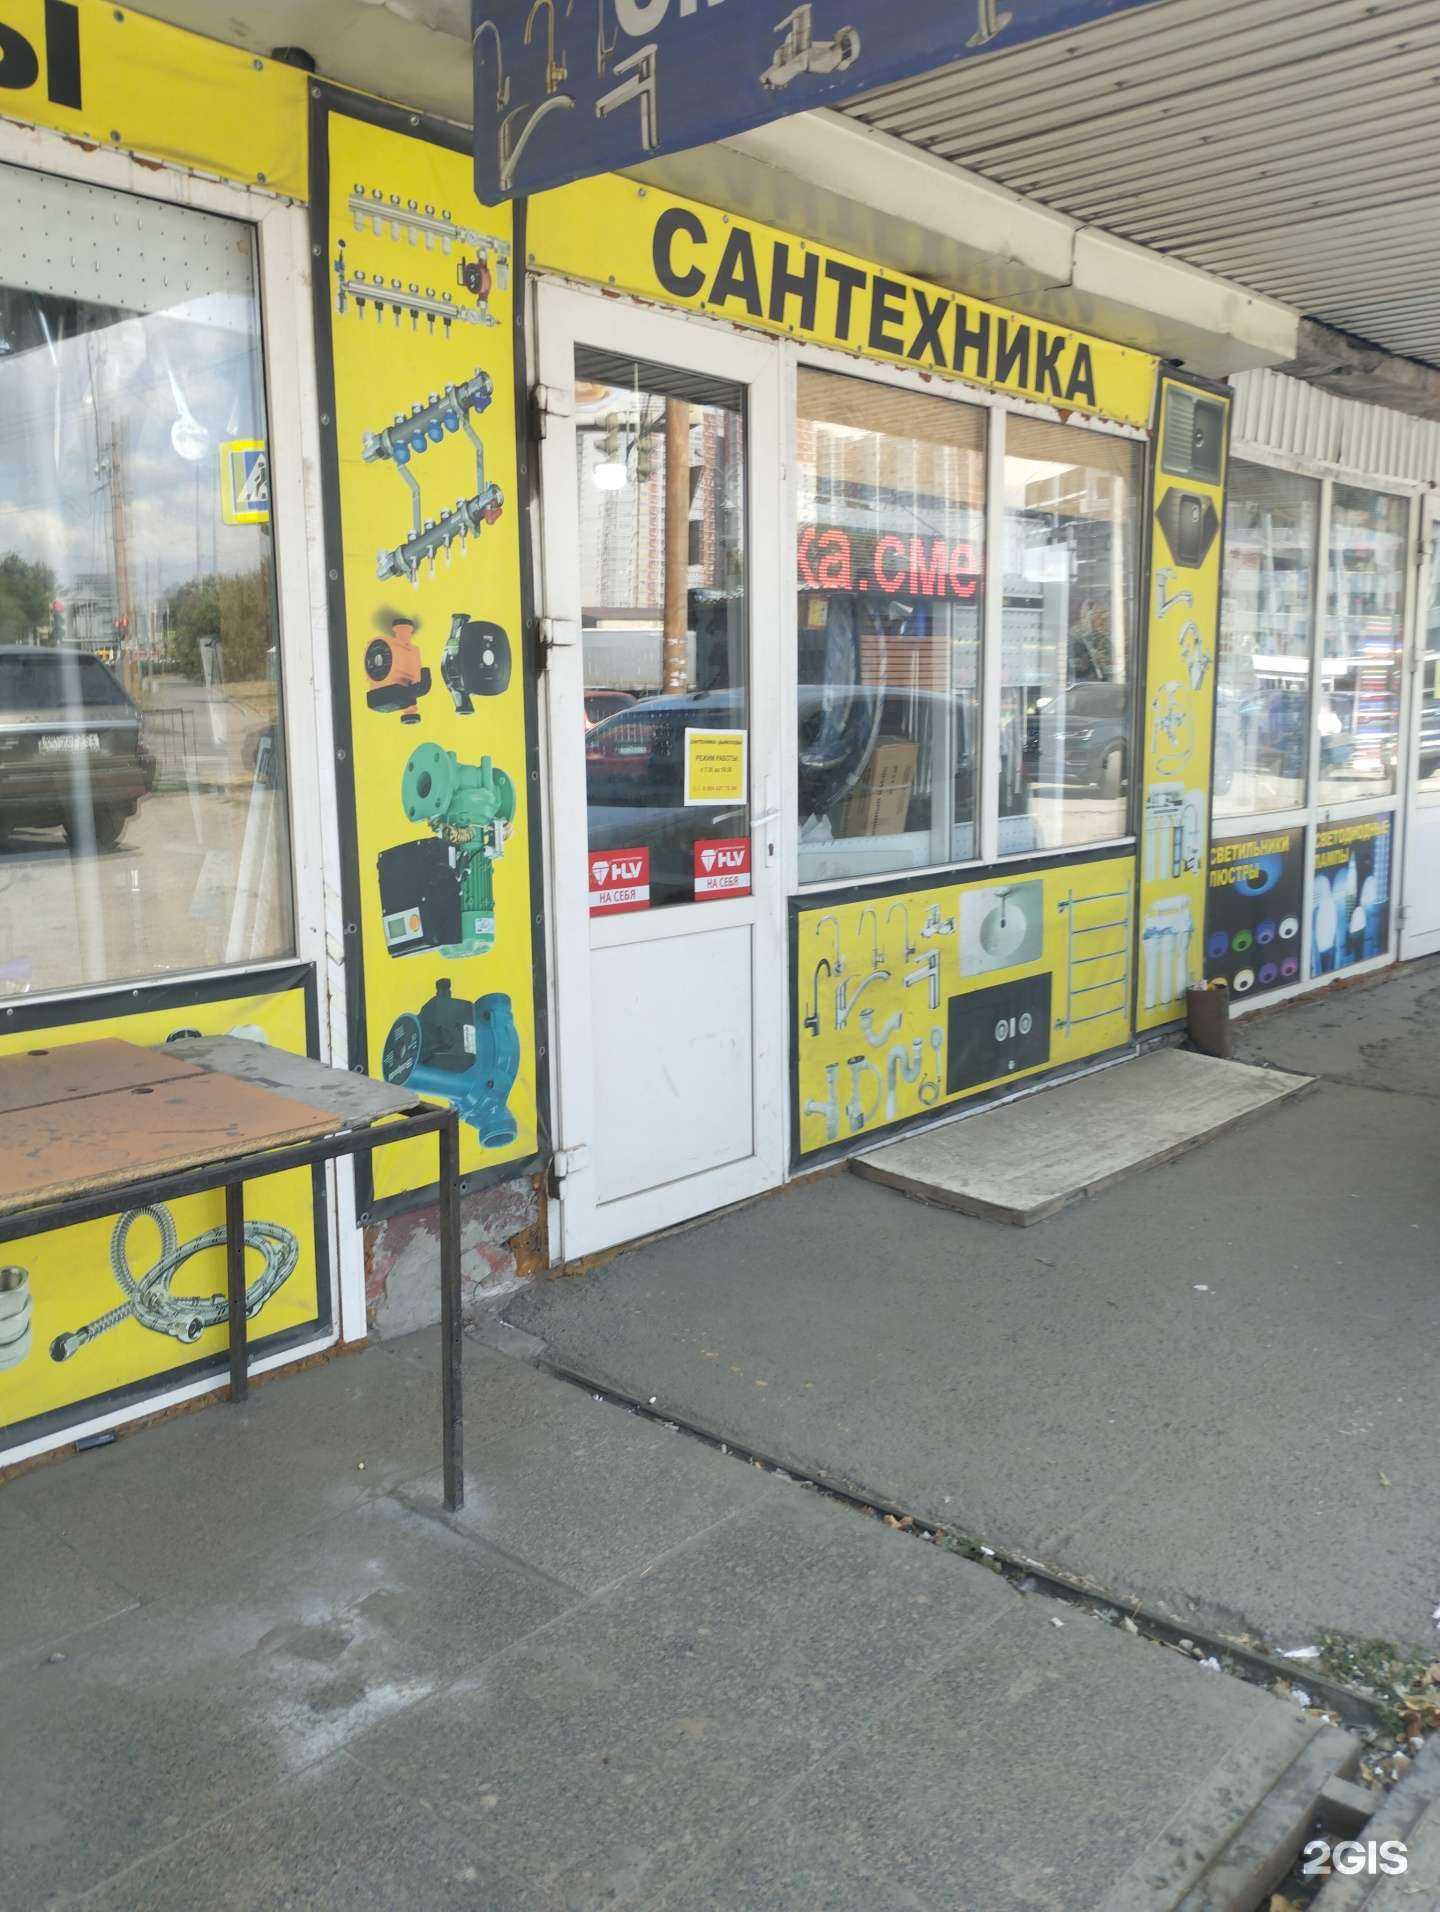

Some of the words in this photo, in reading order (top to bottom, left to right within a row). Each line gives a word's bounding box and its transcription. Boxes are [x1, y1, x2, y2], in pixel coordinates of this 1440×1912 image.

[652, 207, 1097, 406] САНТЕХНИКА
[1210, 834, 1290, 866] СВЕТИЛЬНИКИ
[706, 878, 718, 889] НА
[719, 875, 739, 888] СЕБЯ
[1209, 862, 1260, 888] ЛЮСТРЫ
[600, 891, 612, 904] НА
[613, 889, 636, 902] СЕБЯ
